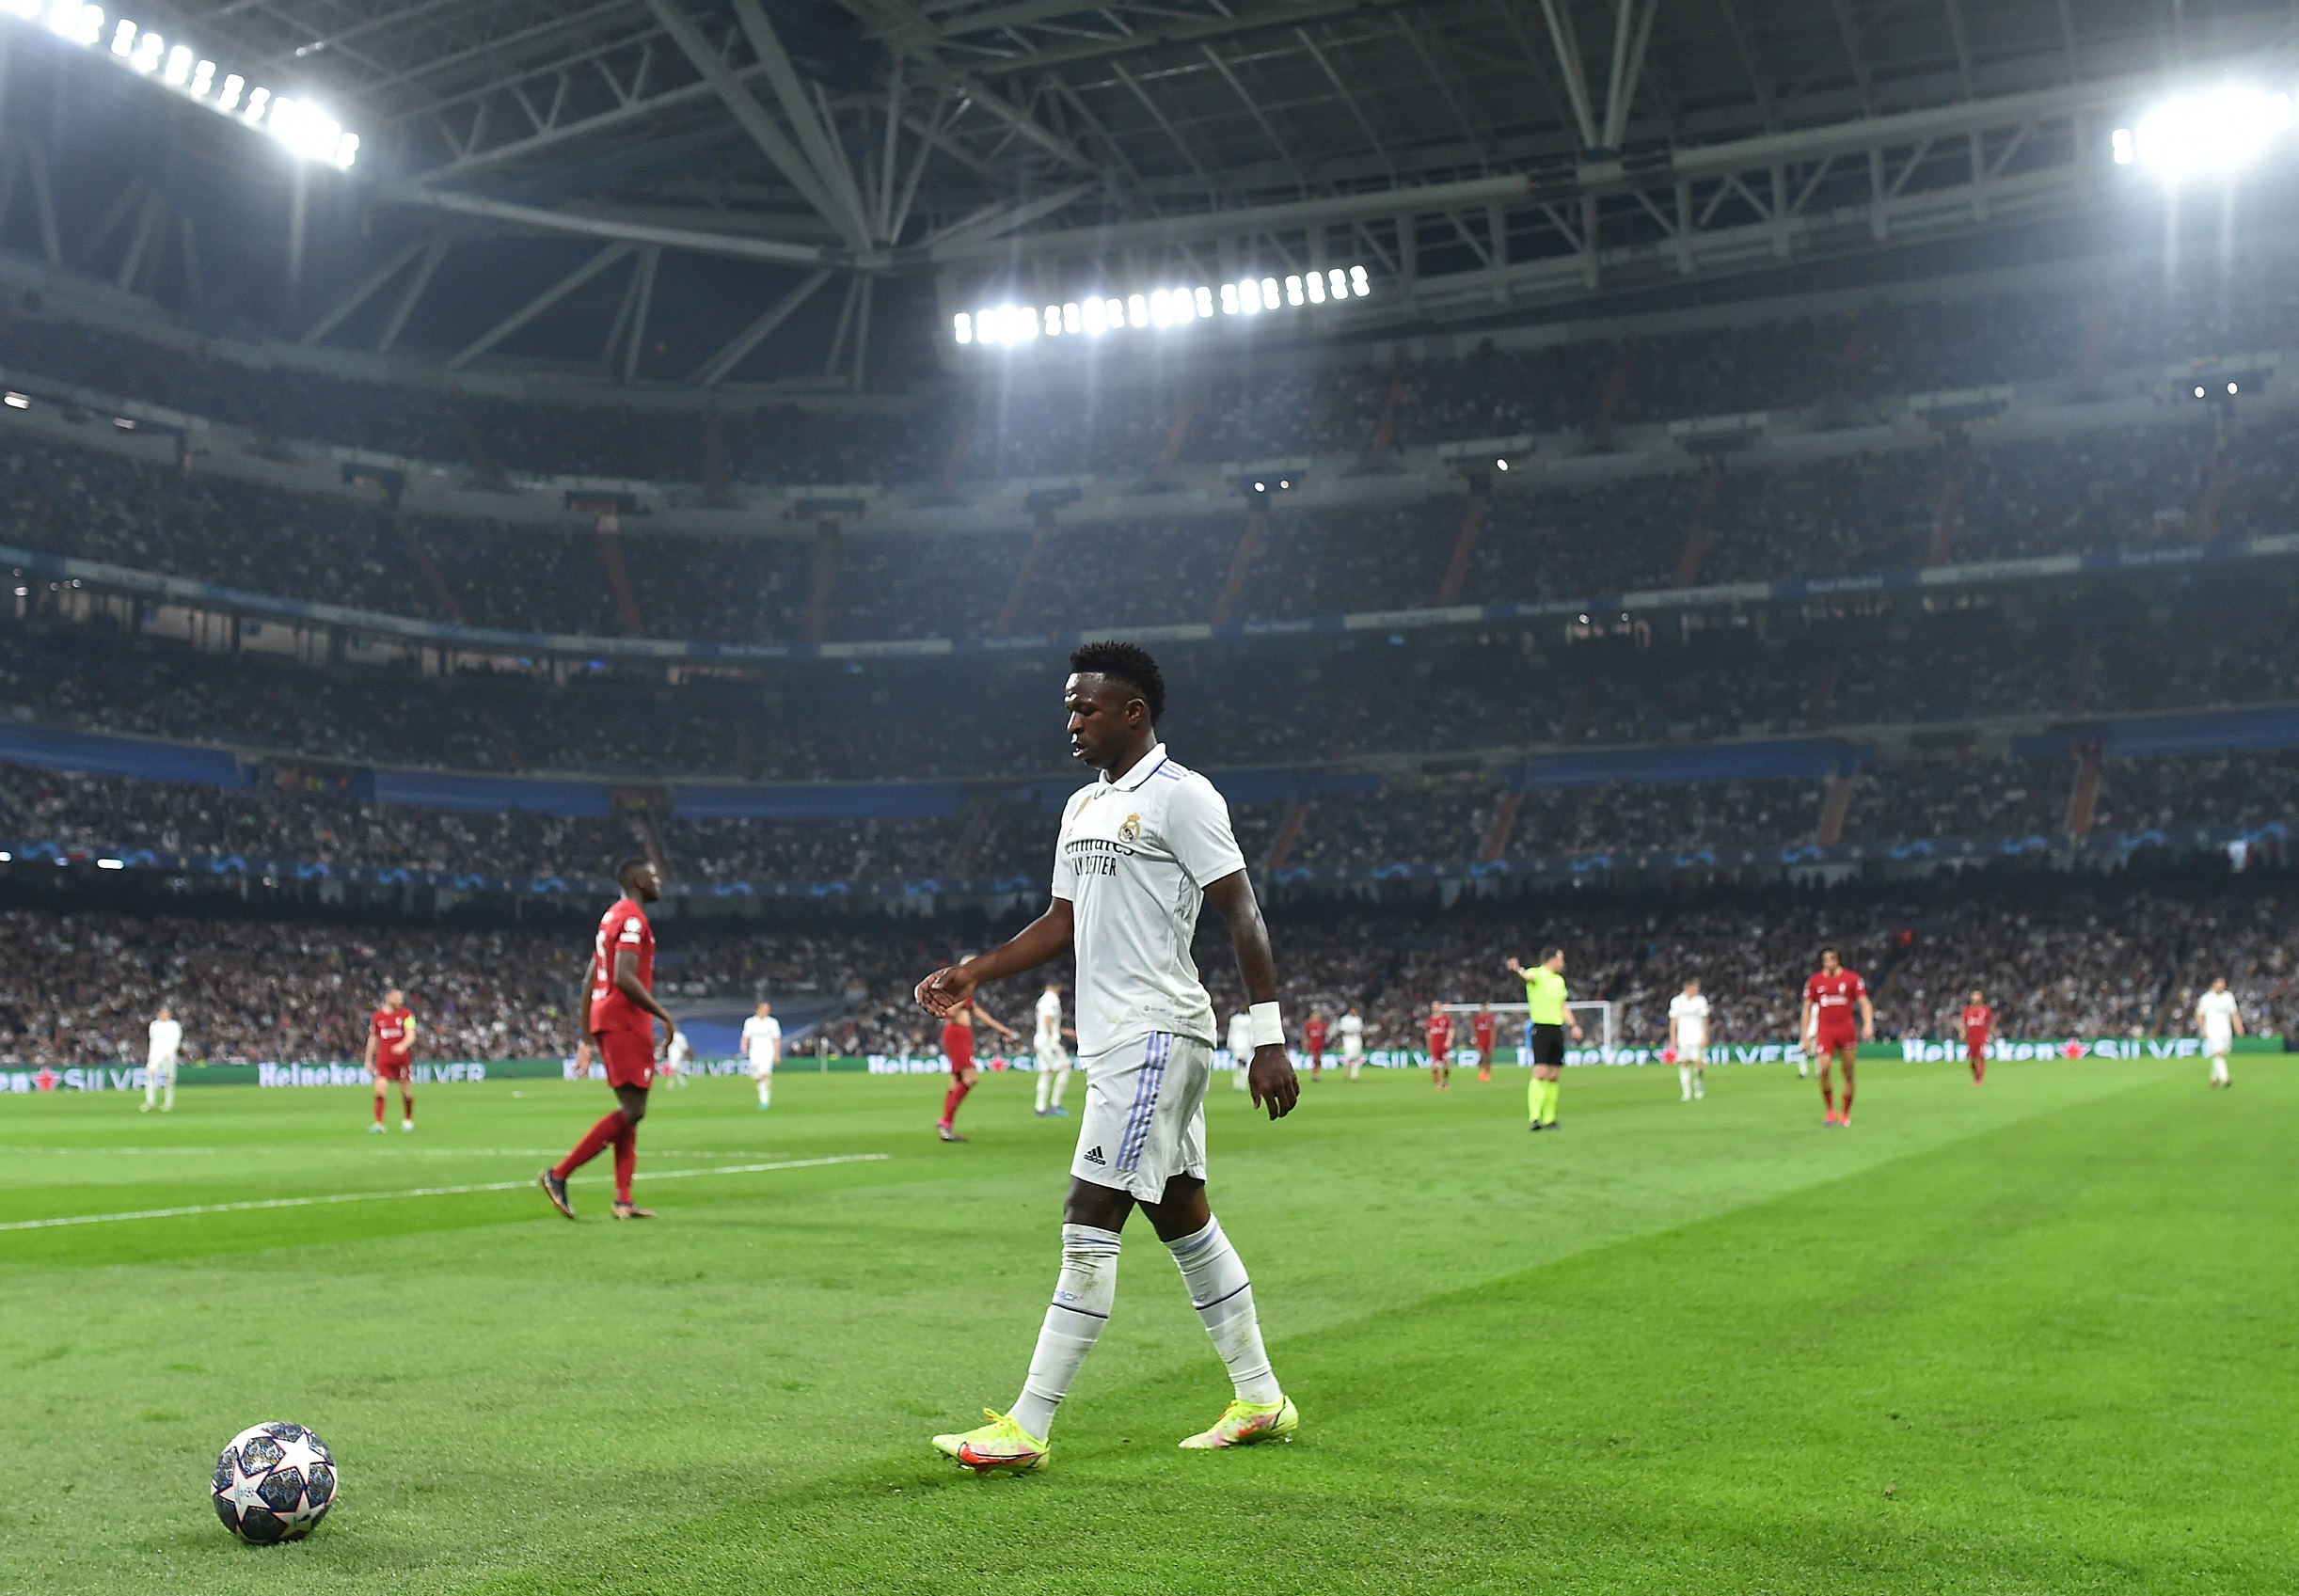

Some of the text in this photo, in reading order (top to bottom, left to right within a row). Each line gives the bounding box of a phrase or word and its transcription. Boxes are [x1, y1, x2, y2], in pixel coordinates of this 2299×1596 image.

[867, 1054, 985, 1074] Heinek
[1369, 1051, 1481, 1068] SILVR
[1515, 1045, 1649, 1067] Hneken
